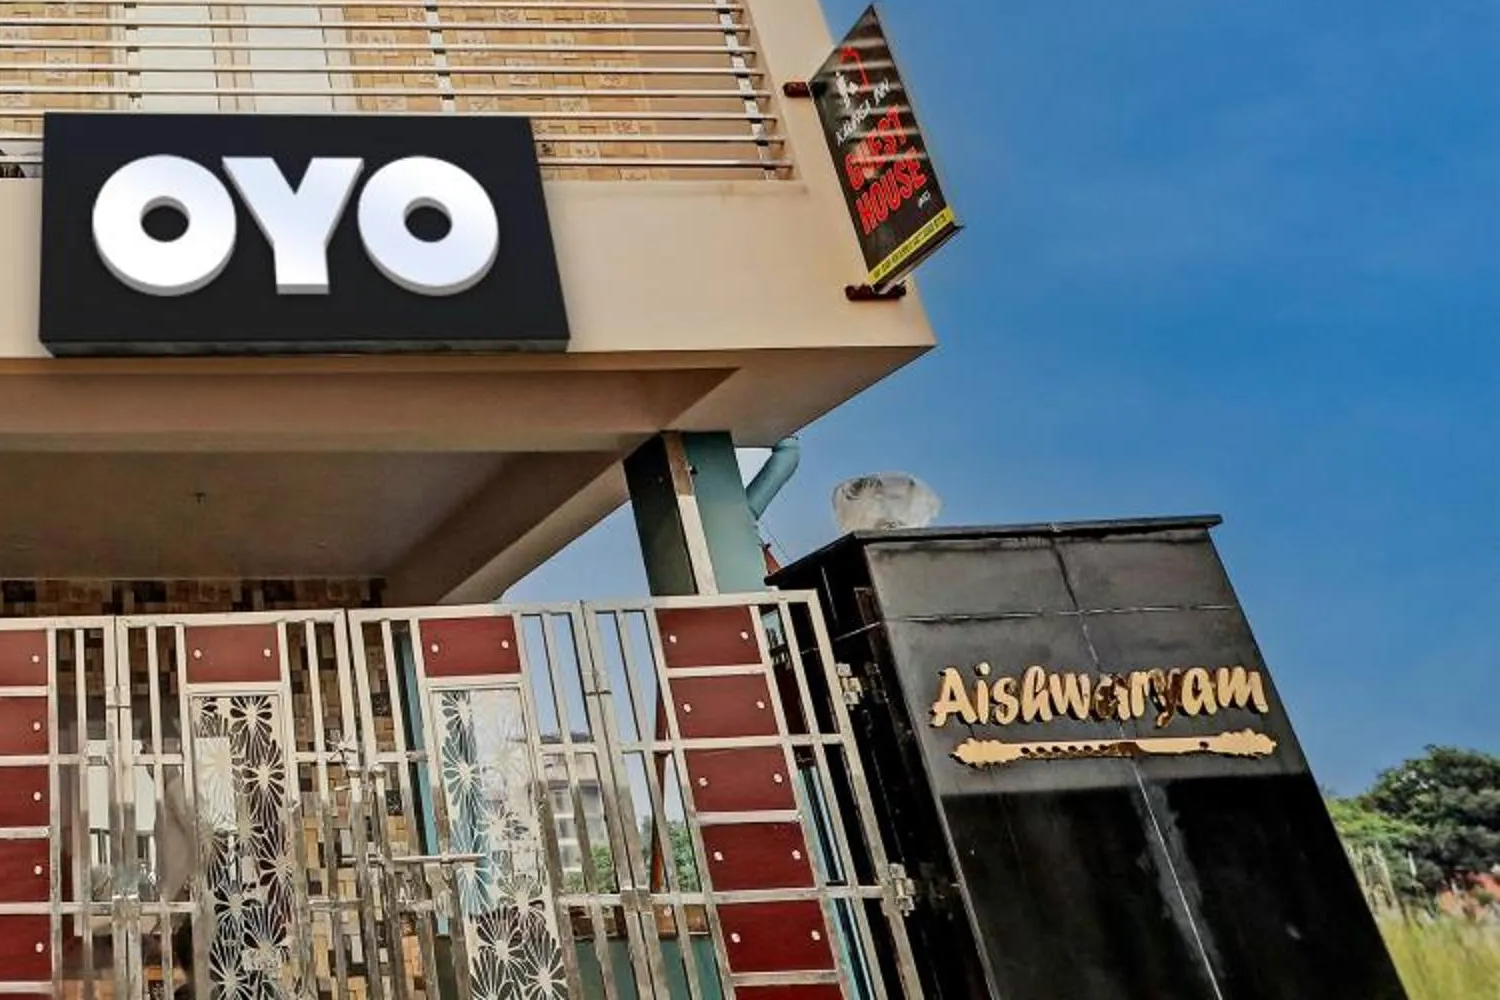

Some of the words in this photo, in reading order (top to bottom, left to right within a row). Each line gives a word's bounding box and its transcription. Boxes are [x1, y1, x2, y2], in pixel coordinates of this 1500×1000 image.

[845, 104, 907, 190] GUEST
[855, 146, 927, 236] HOUSE
[92, 154, 499, 297] OYO
[931, 662, 1269, 727] Aishwaryam
